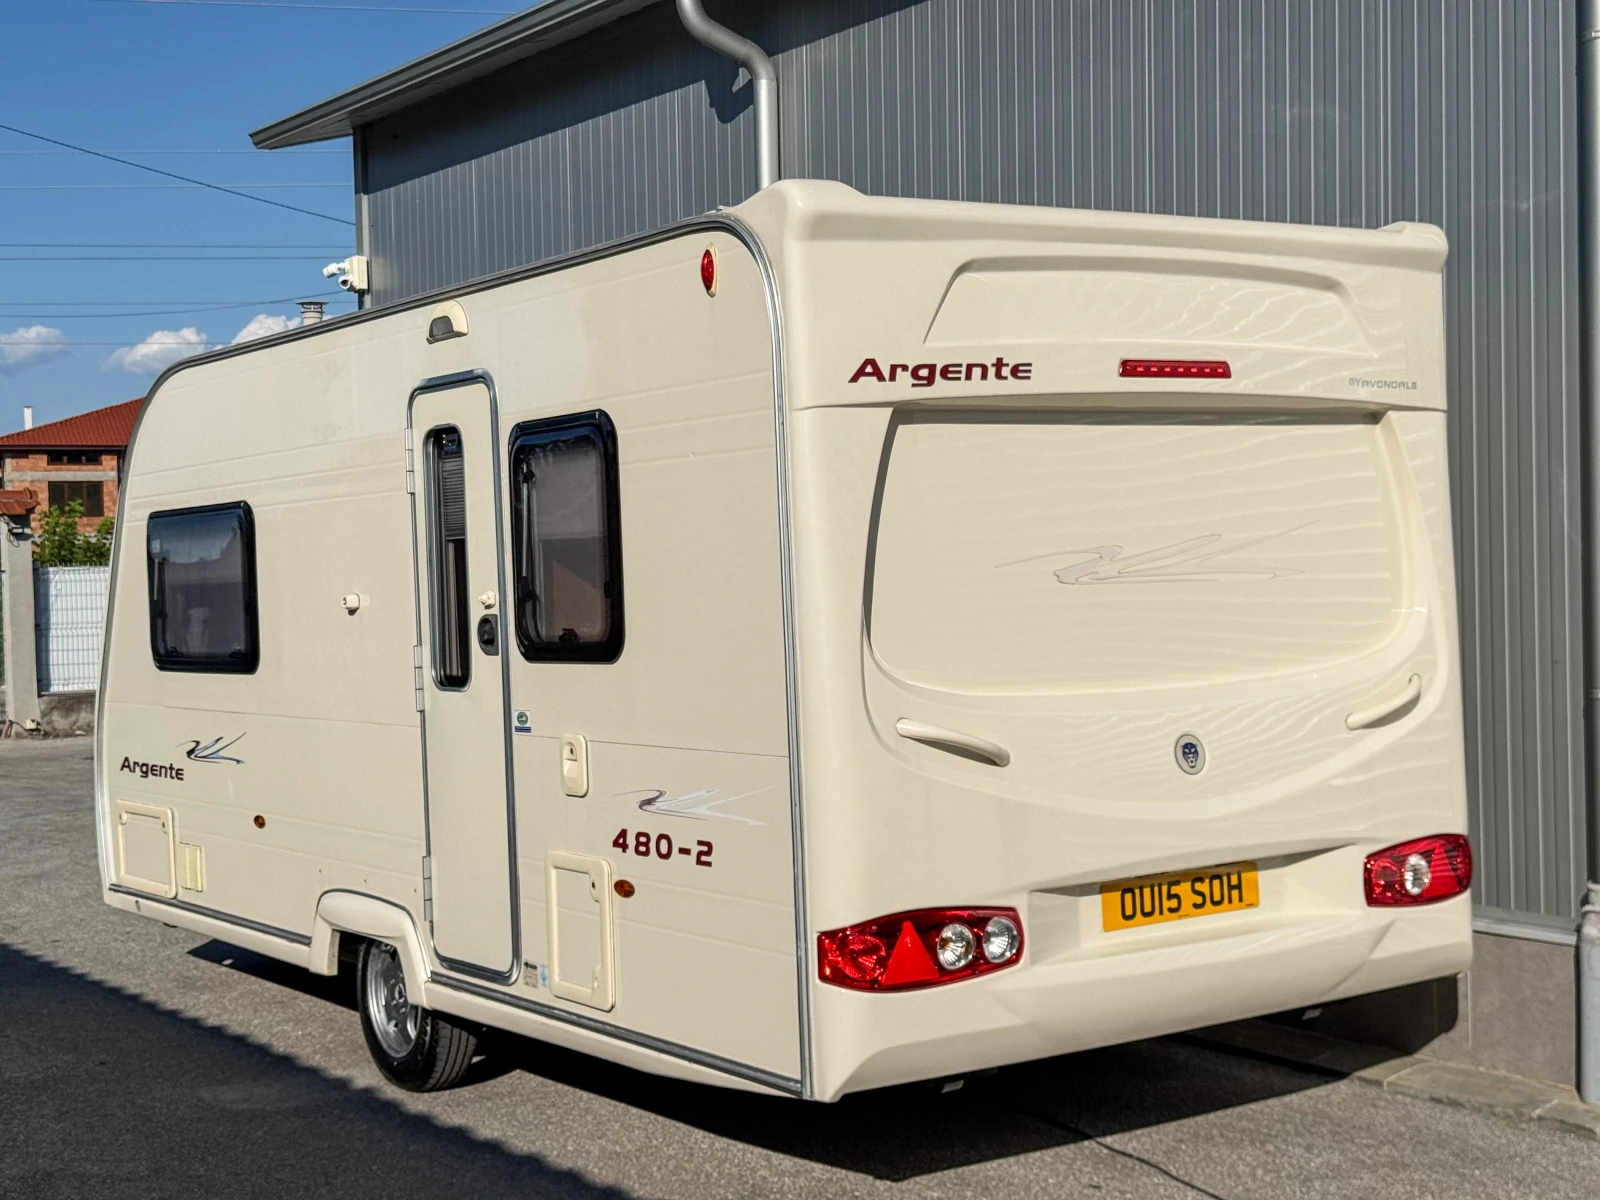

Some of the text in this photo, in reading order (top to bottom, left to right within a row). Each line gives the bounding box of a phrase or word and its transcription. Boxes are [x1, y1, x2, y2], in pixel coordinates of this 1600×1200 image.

[848, 357, 1033, 388] Argente
[1361, 380, 1417, 390] AVONDALE
[120, 756, 185, 781] Argente
[612, 828, 714, 868] 480-2
[1120, 870, 1244, 921] OU15 SOH
